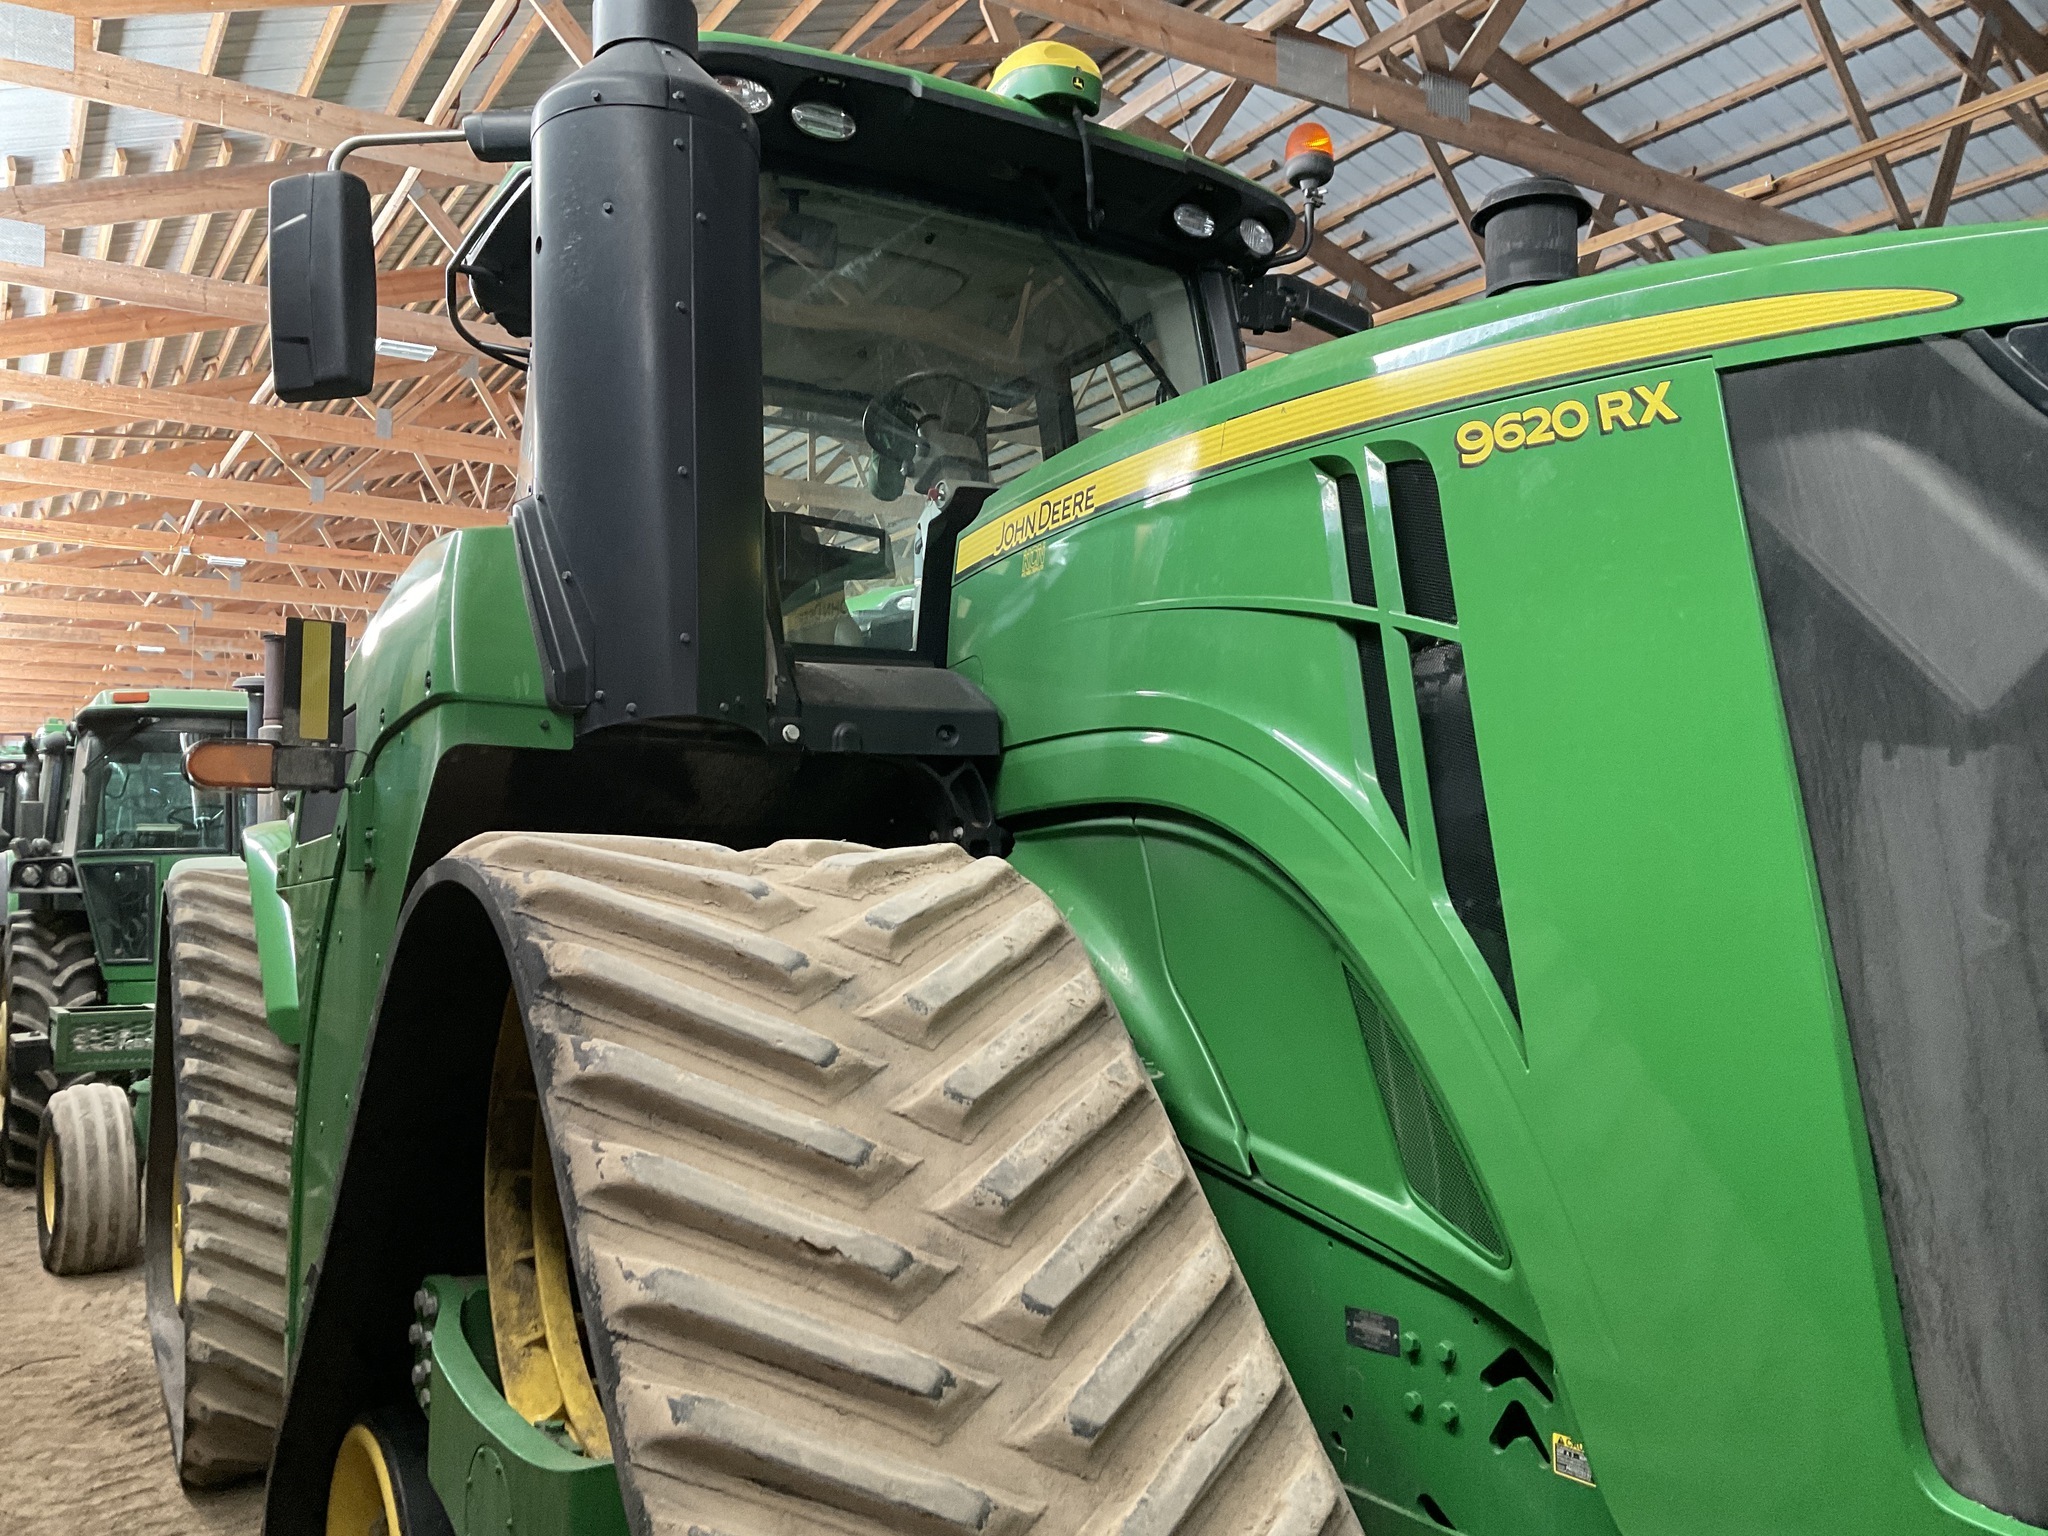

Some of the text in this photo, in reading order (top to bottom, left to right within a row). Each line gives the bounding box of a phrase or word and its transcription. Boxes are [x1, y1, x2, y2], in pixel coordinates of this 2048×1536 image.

[1454, 380, 1682, 468] 9620 RX
[995, 484, 1097, 552] JOHN DEERE
